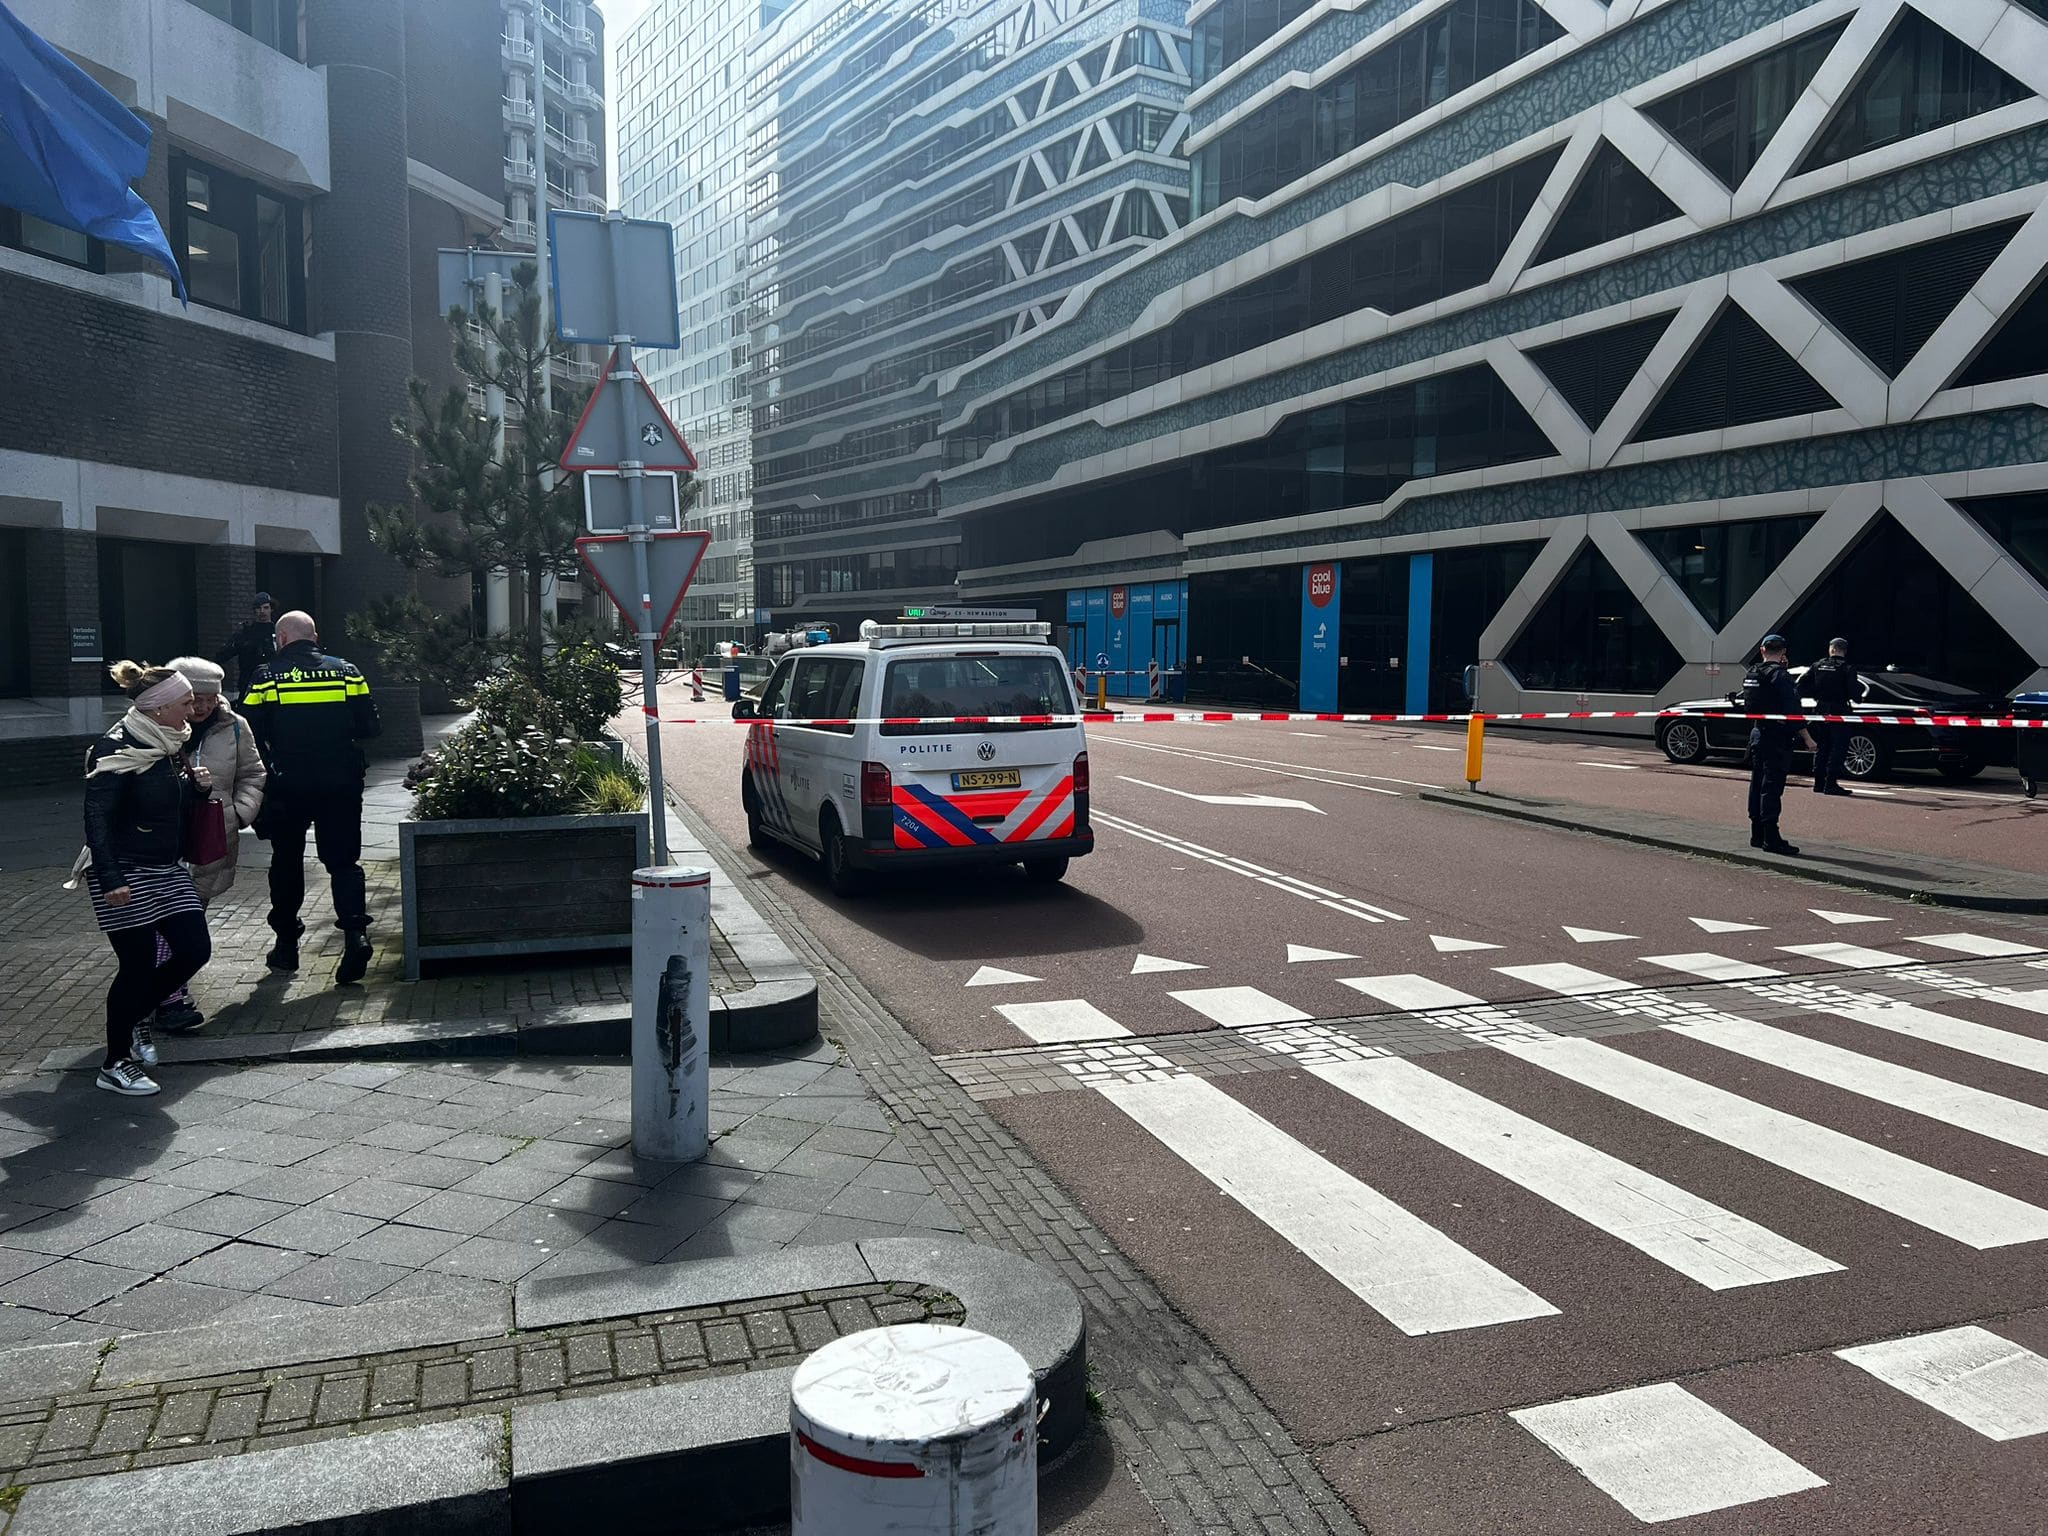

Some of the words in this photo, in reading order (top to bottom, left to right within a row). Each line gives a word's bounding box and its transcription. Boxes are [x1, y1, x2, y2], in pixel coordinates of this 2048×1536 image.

[1312, 571, 1331, 583] cool
[1312, 583, 1331, 595] blue
[1112, 591, 1124, 600] cool
[900, 744, 953, 754] POLITIE
[962, 772, 1017, 786] NS-299-N
